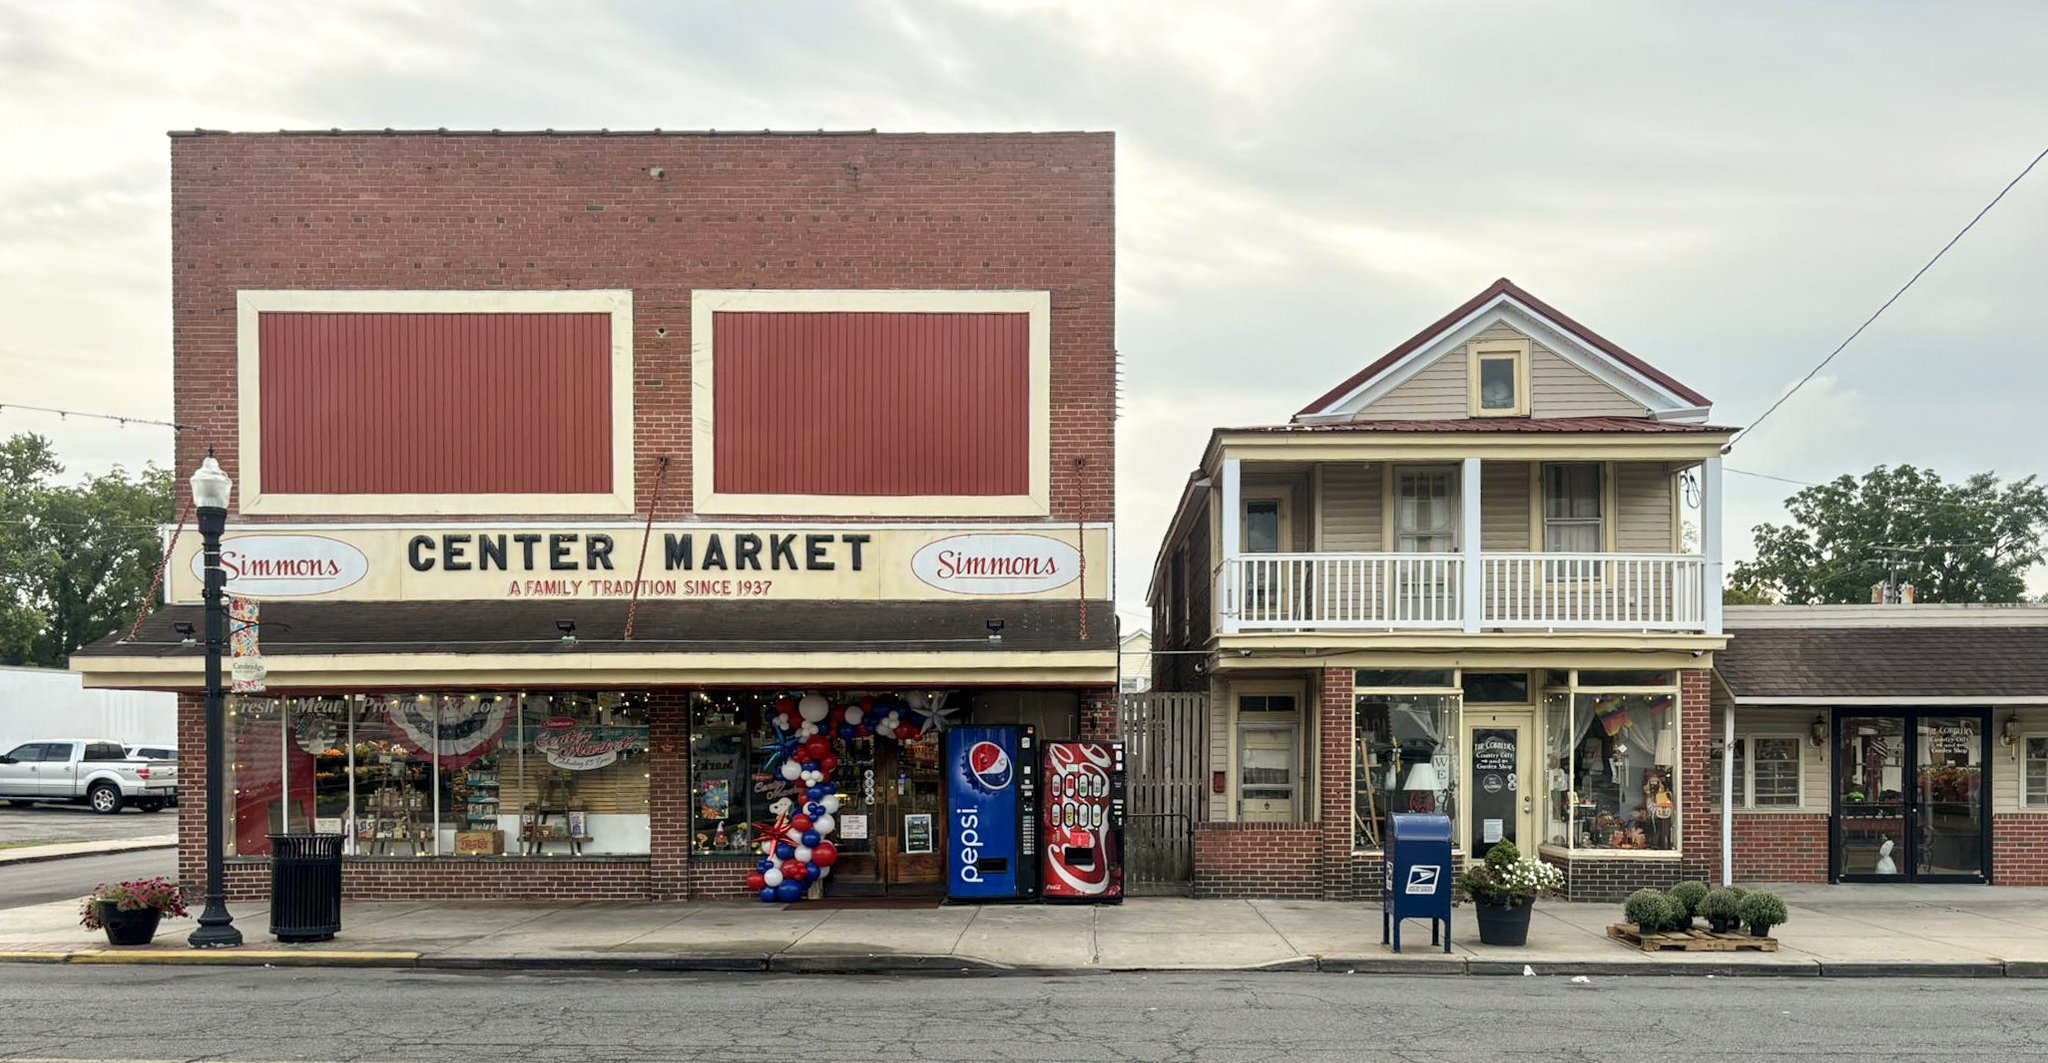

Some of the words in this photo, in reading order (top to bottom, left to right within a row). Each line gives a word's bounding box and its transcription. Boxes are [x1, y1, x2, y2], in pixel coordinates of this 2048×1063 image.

[220, 551, 342, 581] Simmons
[408, 533, 615, 572] CENTER
[663, 533, 871, 572] MARKET
[936, 550, 1060, 579] Simmons
[508, 579, 522, 597] A
[525, 579, 583, 597] FAMILY
[588, 579, 677, 597] TRADTION
[683, 580, 732, 597] SINCE
[736, 580, 773, 597] 1937
[236, 698, 275, 714] resh
[957, 808, 984, 883] pepsi
